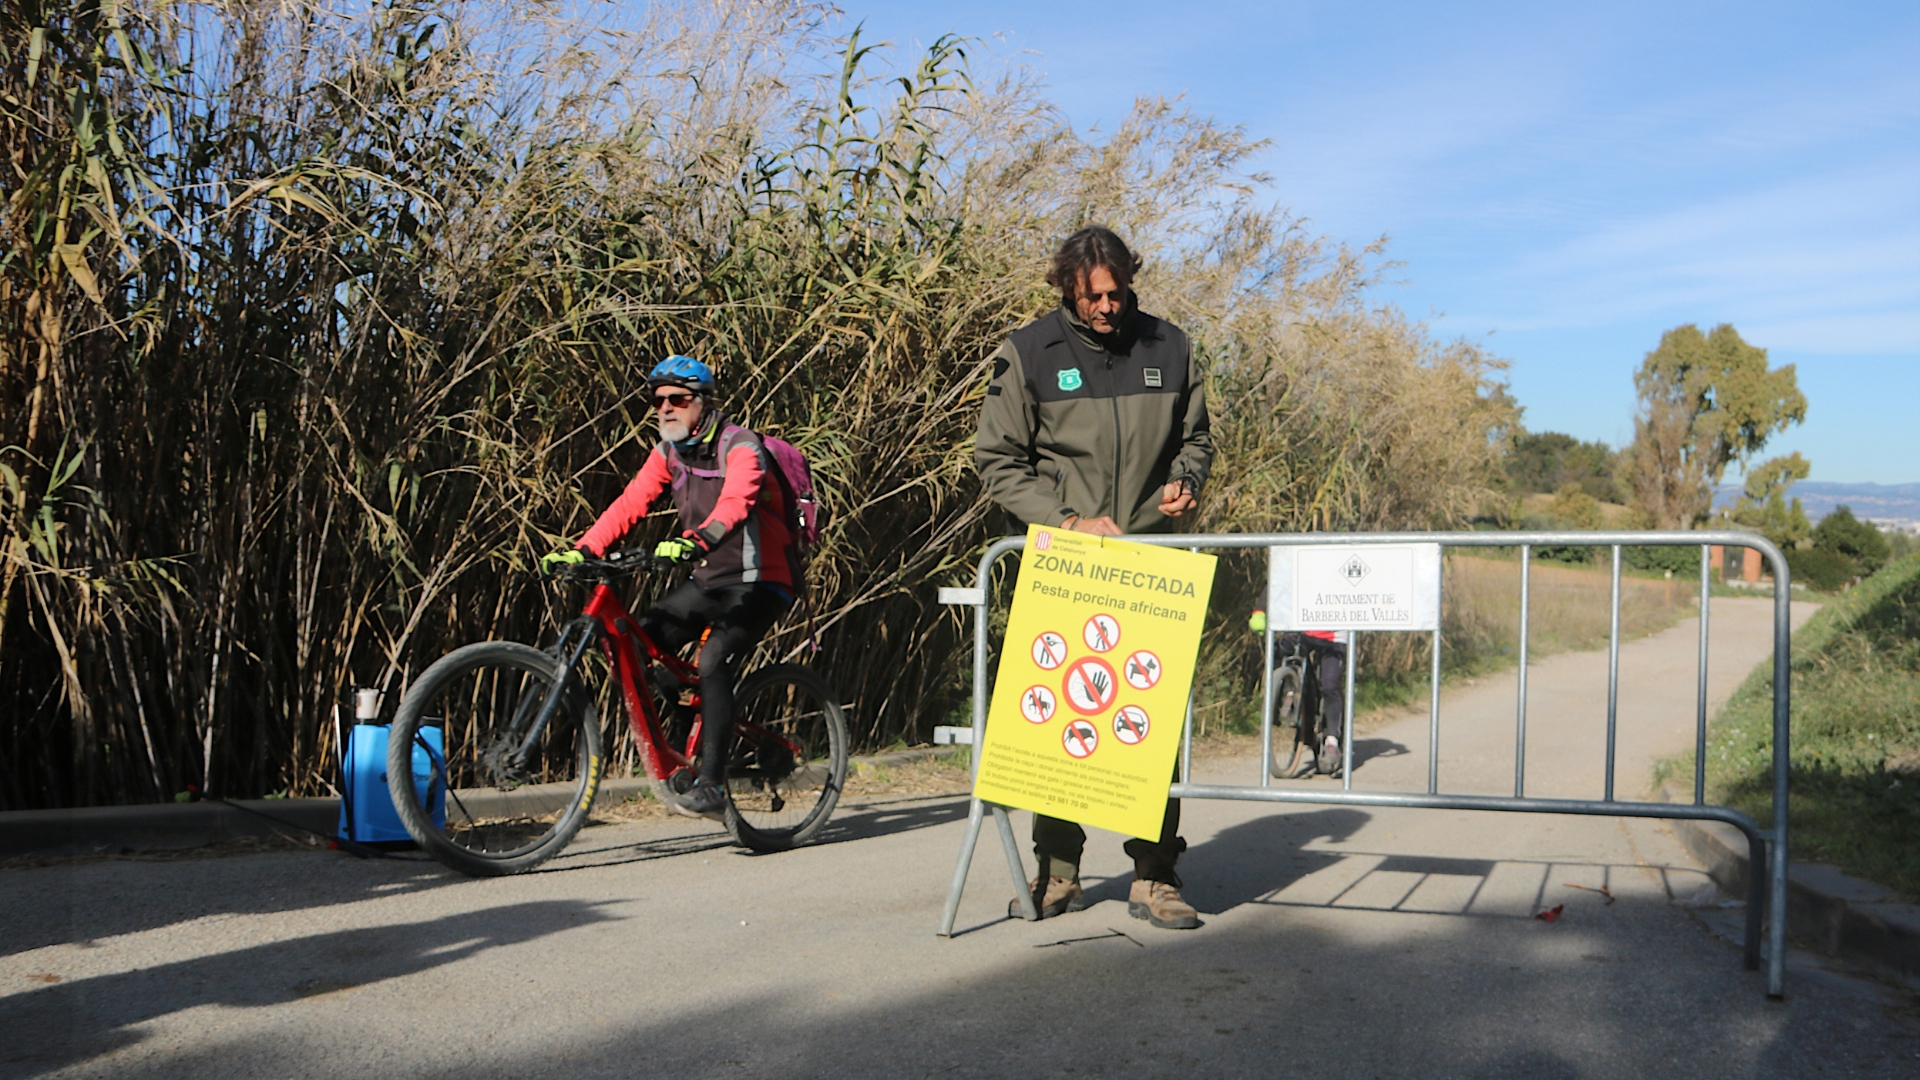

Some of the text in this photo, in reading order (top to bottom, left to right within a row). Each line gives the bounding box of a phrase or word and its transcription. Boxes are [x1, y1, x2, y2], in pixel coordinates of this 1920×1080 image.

[1053, 536, 1083, 546] Generalitat
[1060, 546, 1086, 555] Catalunya
[1033, 554, 1195, 598] ZONA INFECTADA
[1032, 580, 1187, 622] Pesta porcina africana
[1315, 593, 1395, 605] AJUNTAMENT DE
[1302, 607, 1409, 622] BARBERÀ DEL VALLÈS
